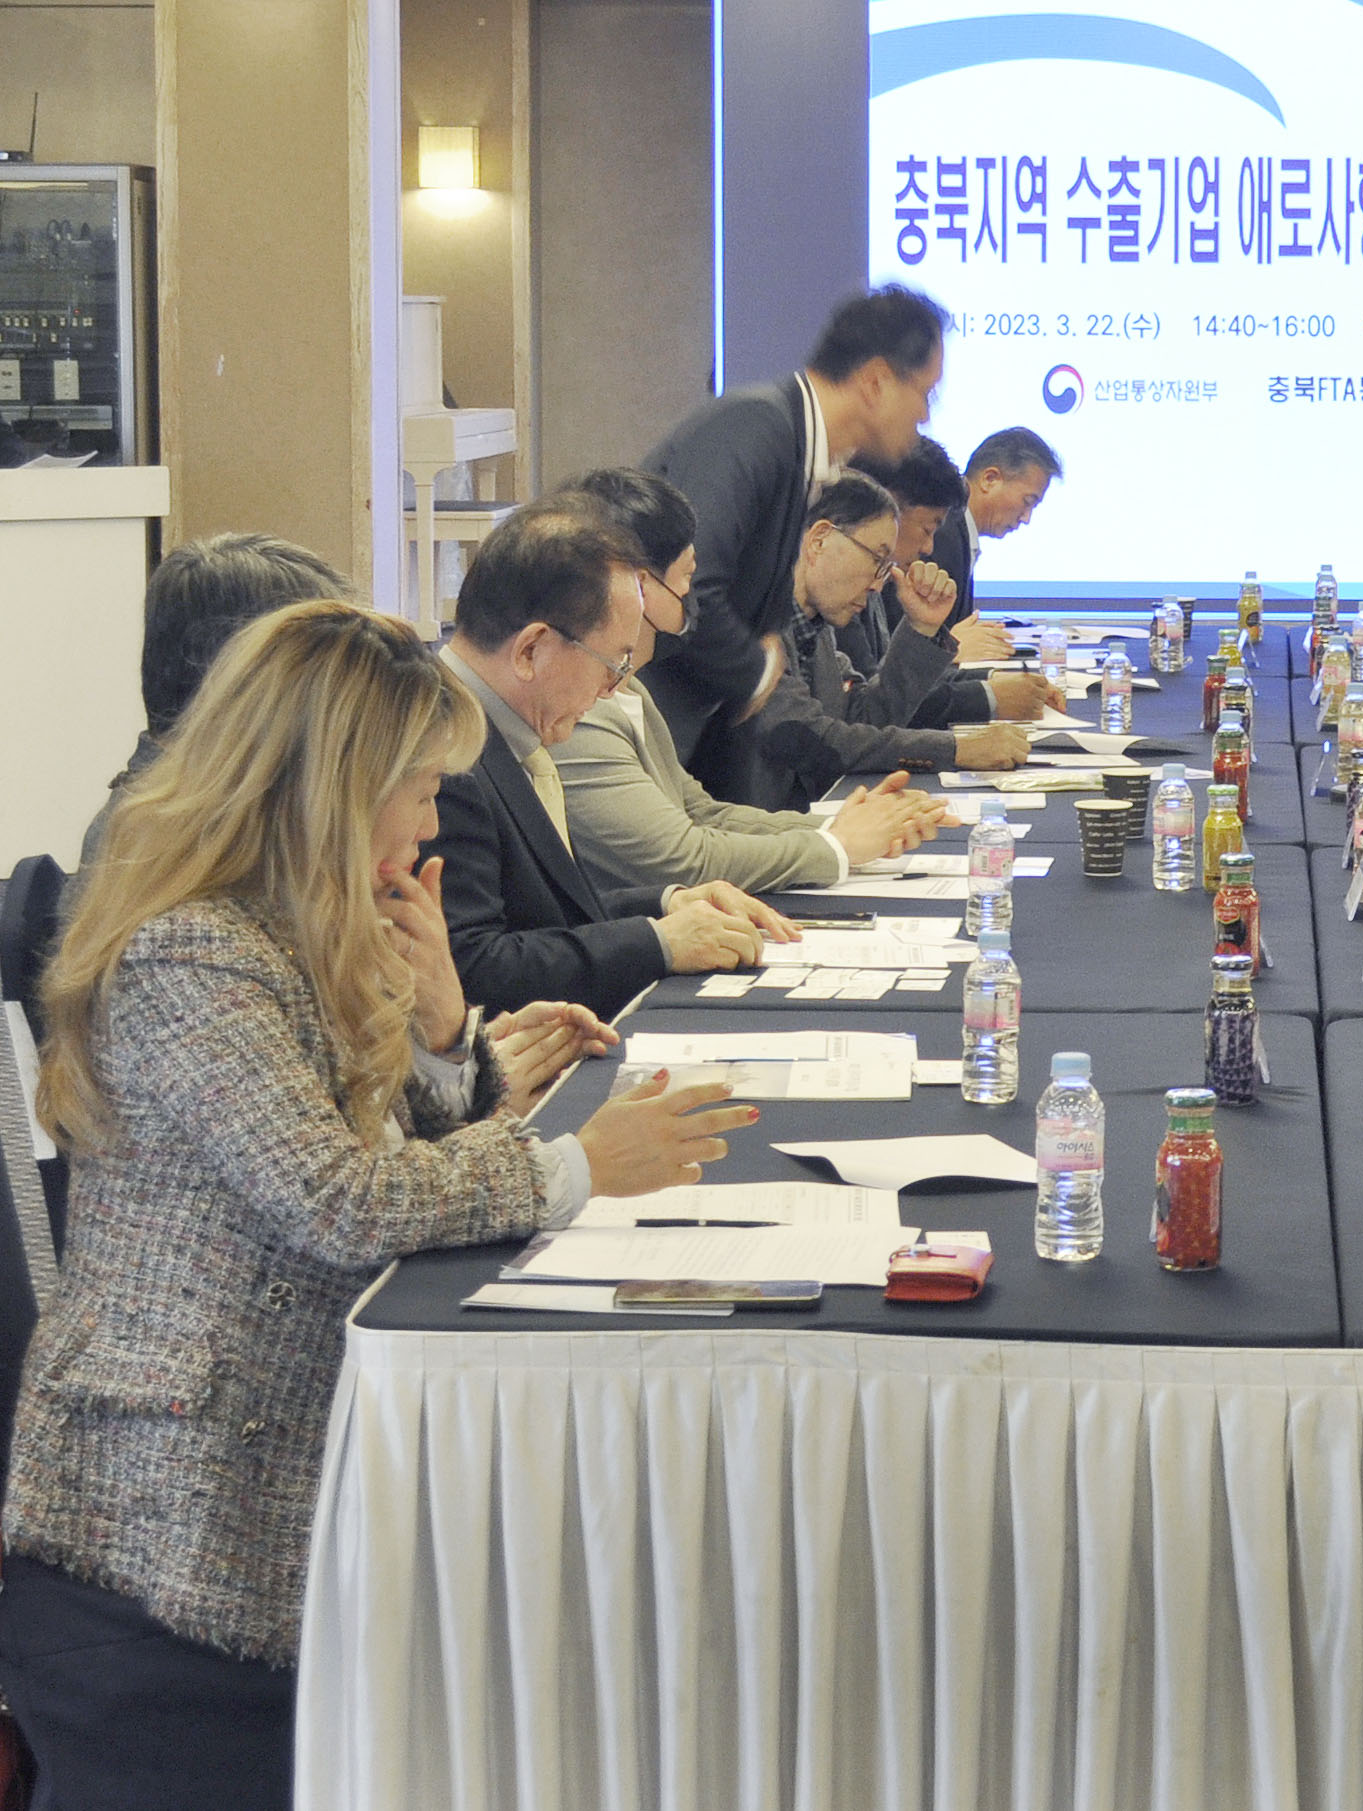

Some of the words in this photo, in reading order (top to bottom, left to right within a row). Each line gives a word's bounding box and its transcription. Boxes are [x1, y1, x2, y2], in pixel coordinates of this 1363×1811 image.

[894, 154, 1048, 266] 충북지역
[1066, 155, 1220, 265] 수출기업
[945, 312, 975, 338] 시:
[984, 312, 1047, 337] 2023.
[1056, 313, 1077, 337] 3.
[1086, 311, 1161, 341] 22.(수)
[1192, 313, 1336, 338] 14:40~16:00
[1095, 379, 1218, 403] 산업통상자원부
